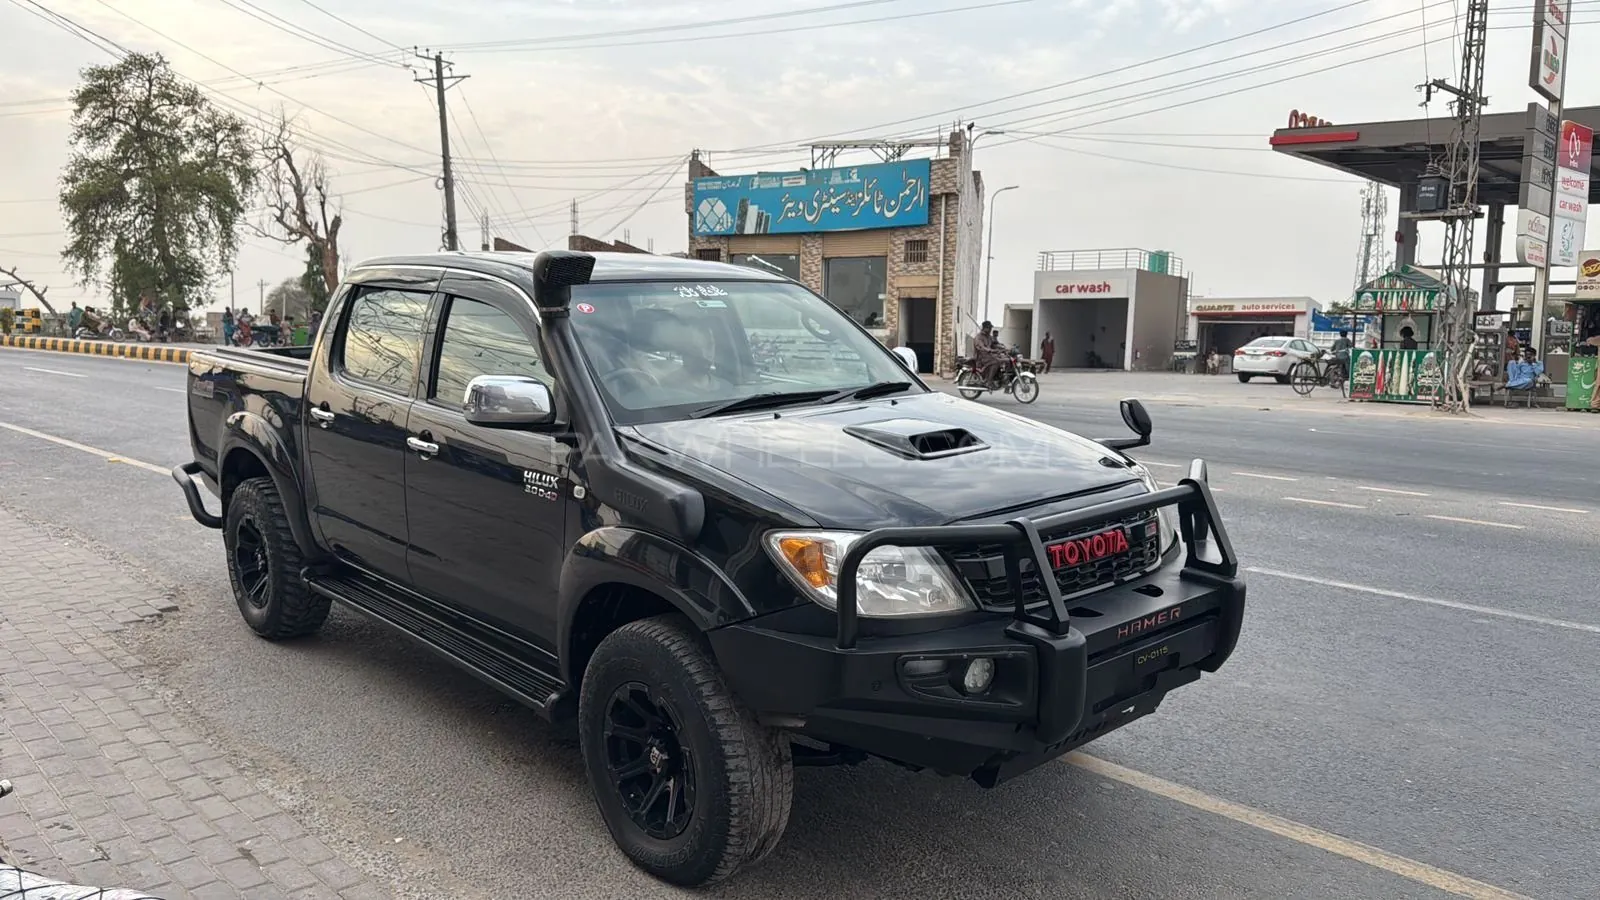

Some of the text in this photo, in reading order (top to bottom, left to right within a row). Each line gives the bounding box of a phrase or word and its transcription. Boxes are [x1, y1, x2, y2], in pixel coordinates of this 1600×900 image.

[1055, 281, 1111, 294] car wash
[1241, 302, 1261, 311] auto
[1261, 302, 1295, 311] services
[523, 470, 559, 490] HILUX
[613, 486, 649, 513] HILUX
[1047, 529, 1129, 568] TOYOTA
[1117, 607, 1182, 639] HAMER
